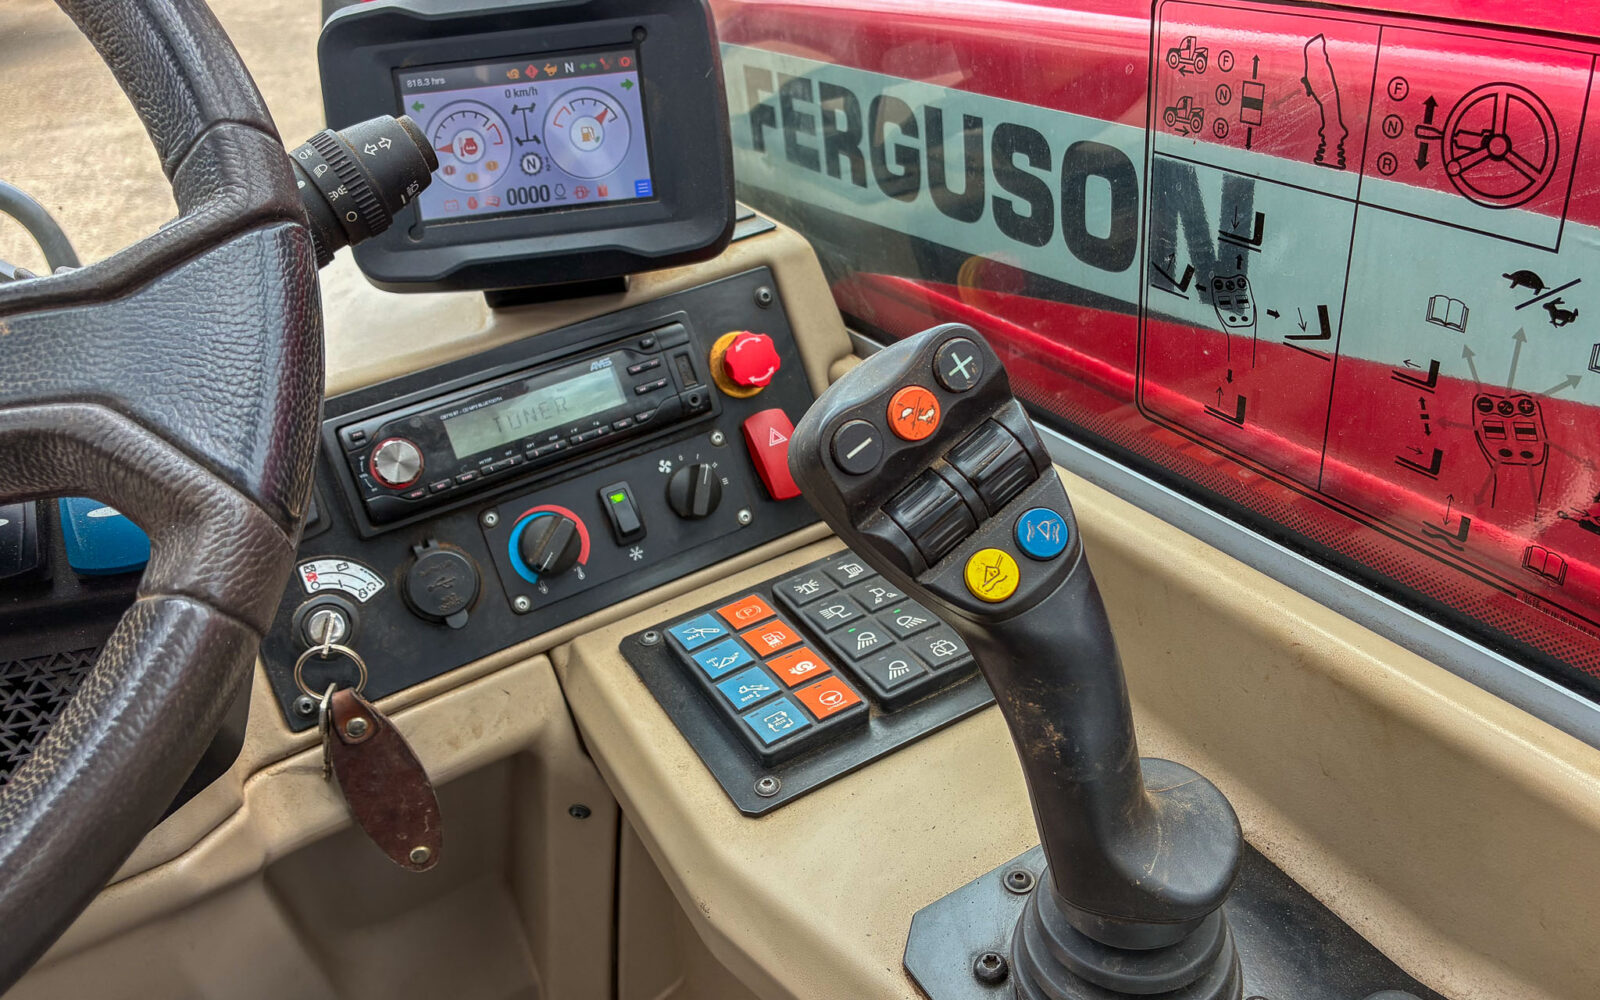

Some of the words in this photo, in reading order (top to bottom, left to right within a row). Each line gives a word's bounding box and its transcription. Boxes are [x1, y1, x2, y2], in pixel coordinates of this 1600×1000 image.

[564, 62, 575, 73] N
[431, 77, 446, 85] hrs
[513, 86, 538, 98] km/h
[526, 158, 537, 170] N
[506, 184, 551, 206] 0000
[743, 64, 1256, 315] FERGUSON
[493, 396, 568, 432] TUNER
[686, 633, 700, 641] MAX
